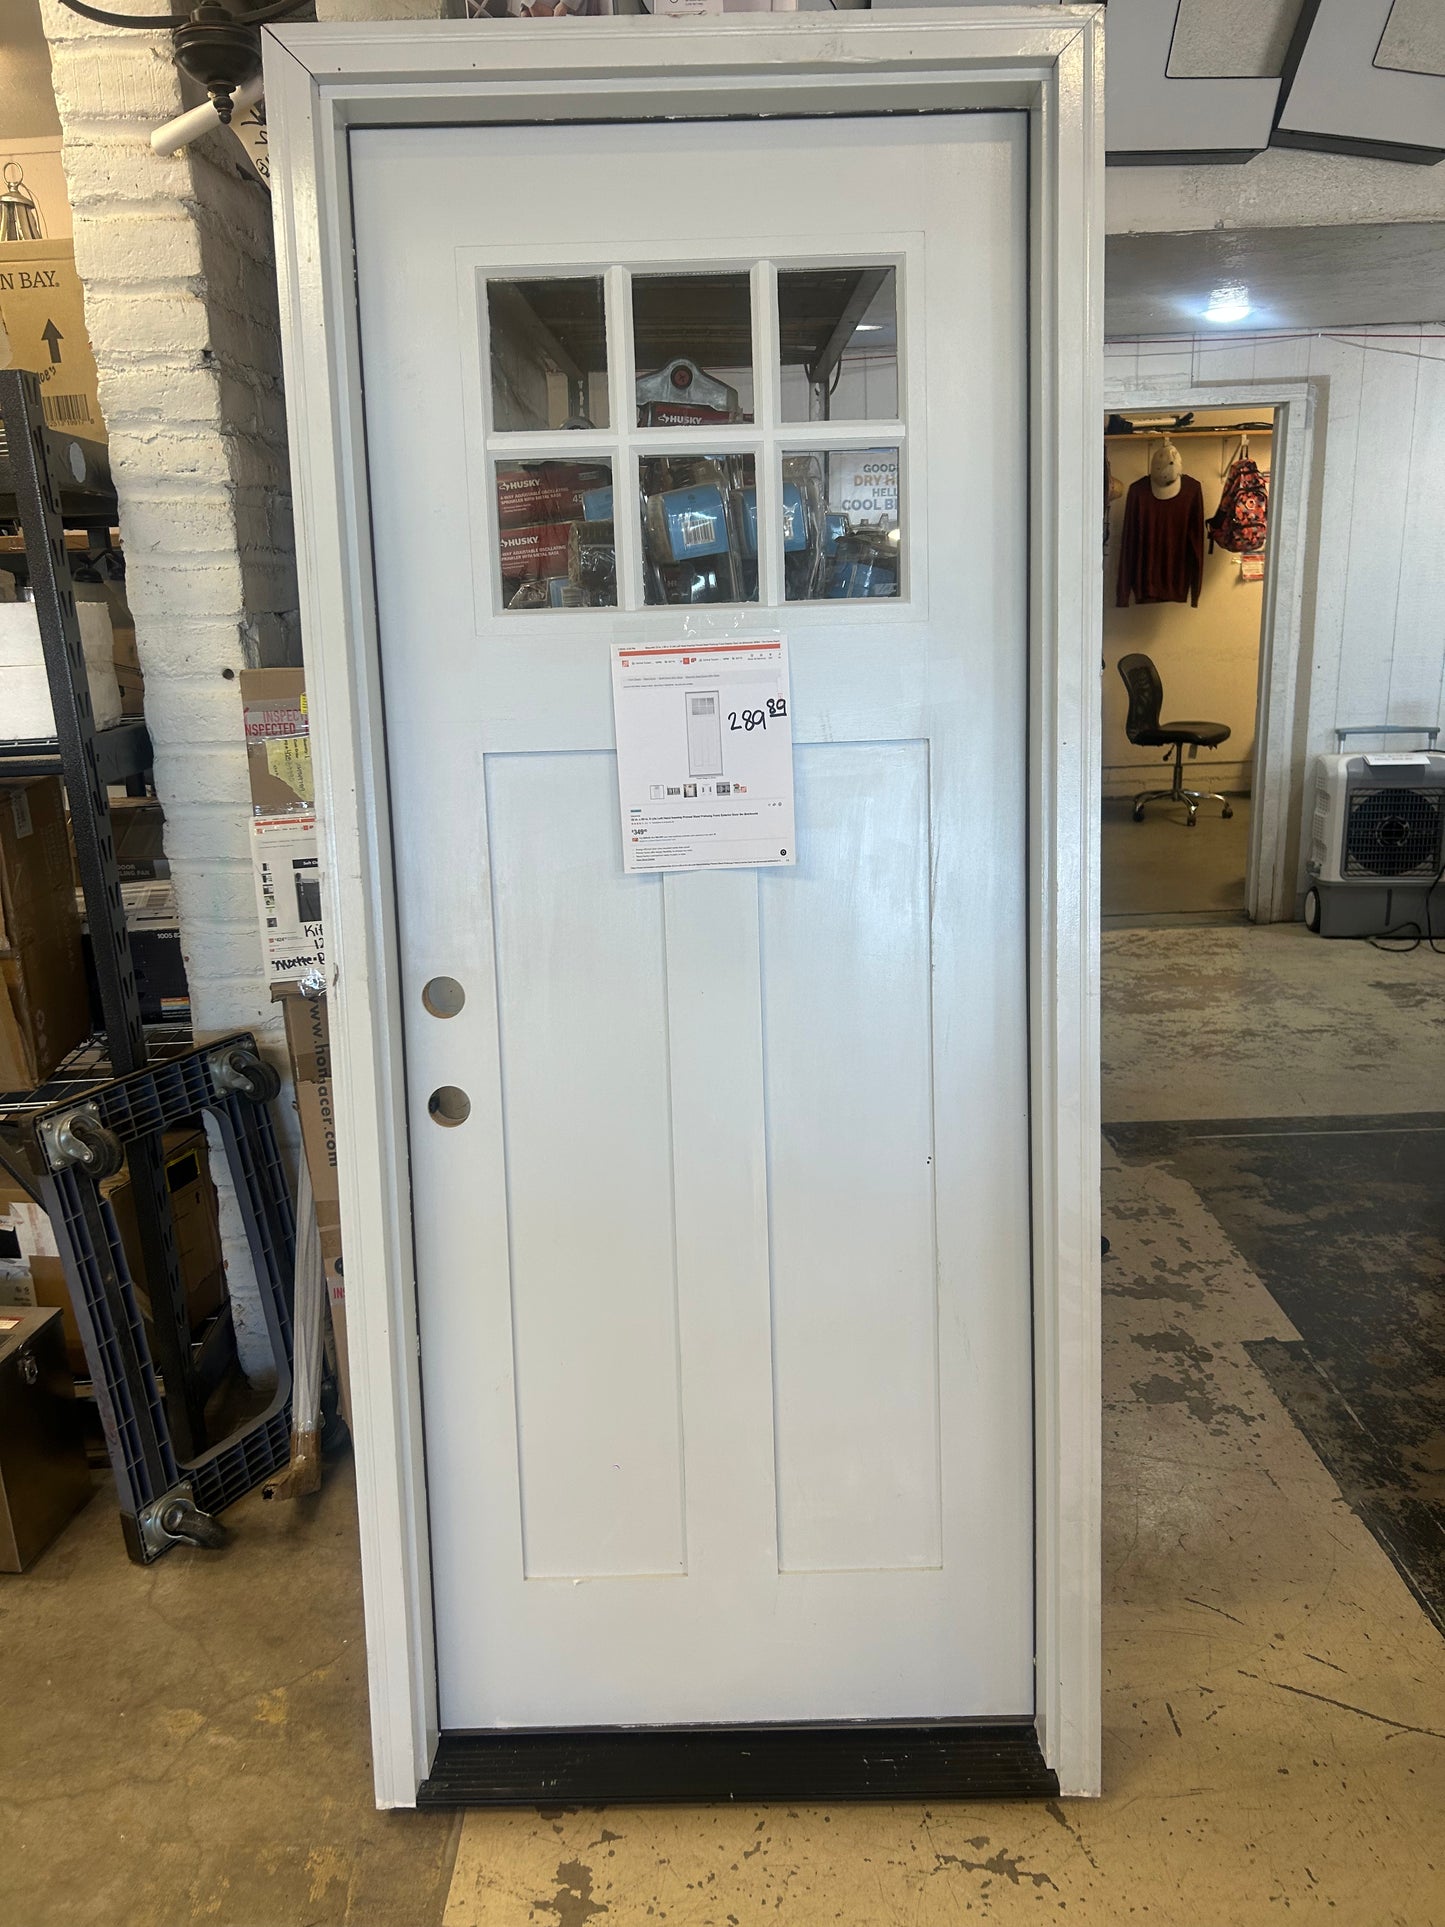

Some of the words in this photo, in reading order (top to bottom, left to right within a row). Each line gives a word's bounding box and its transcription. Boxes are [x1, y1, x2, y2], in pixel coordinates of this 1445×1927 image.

[669, 415, 702, 425] HUSKY
[509, 478, 541, 490] HUSKY
[854, 475, 882, 486] DRY
[884, 474, 897, 486] H
[841, 499, 882, 511] COOL
[885, 499, 897, 510] B
[508, 536, 539, 547] HUSKY
[262, 708, 308, 723] INSPECT
[728, 709, 767, 731] 289
